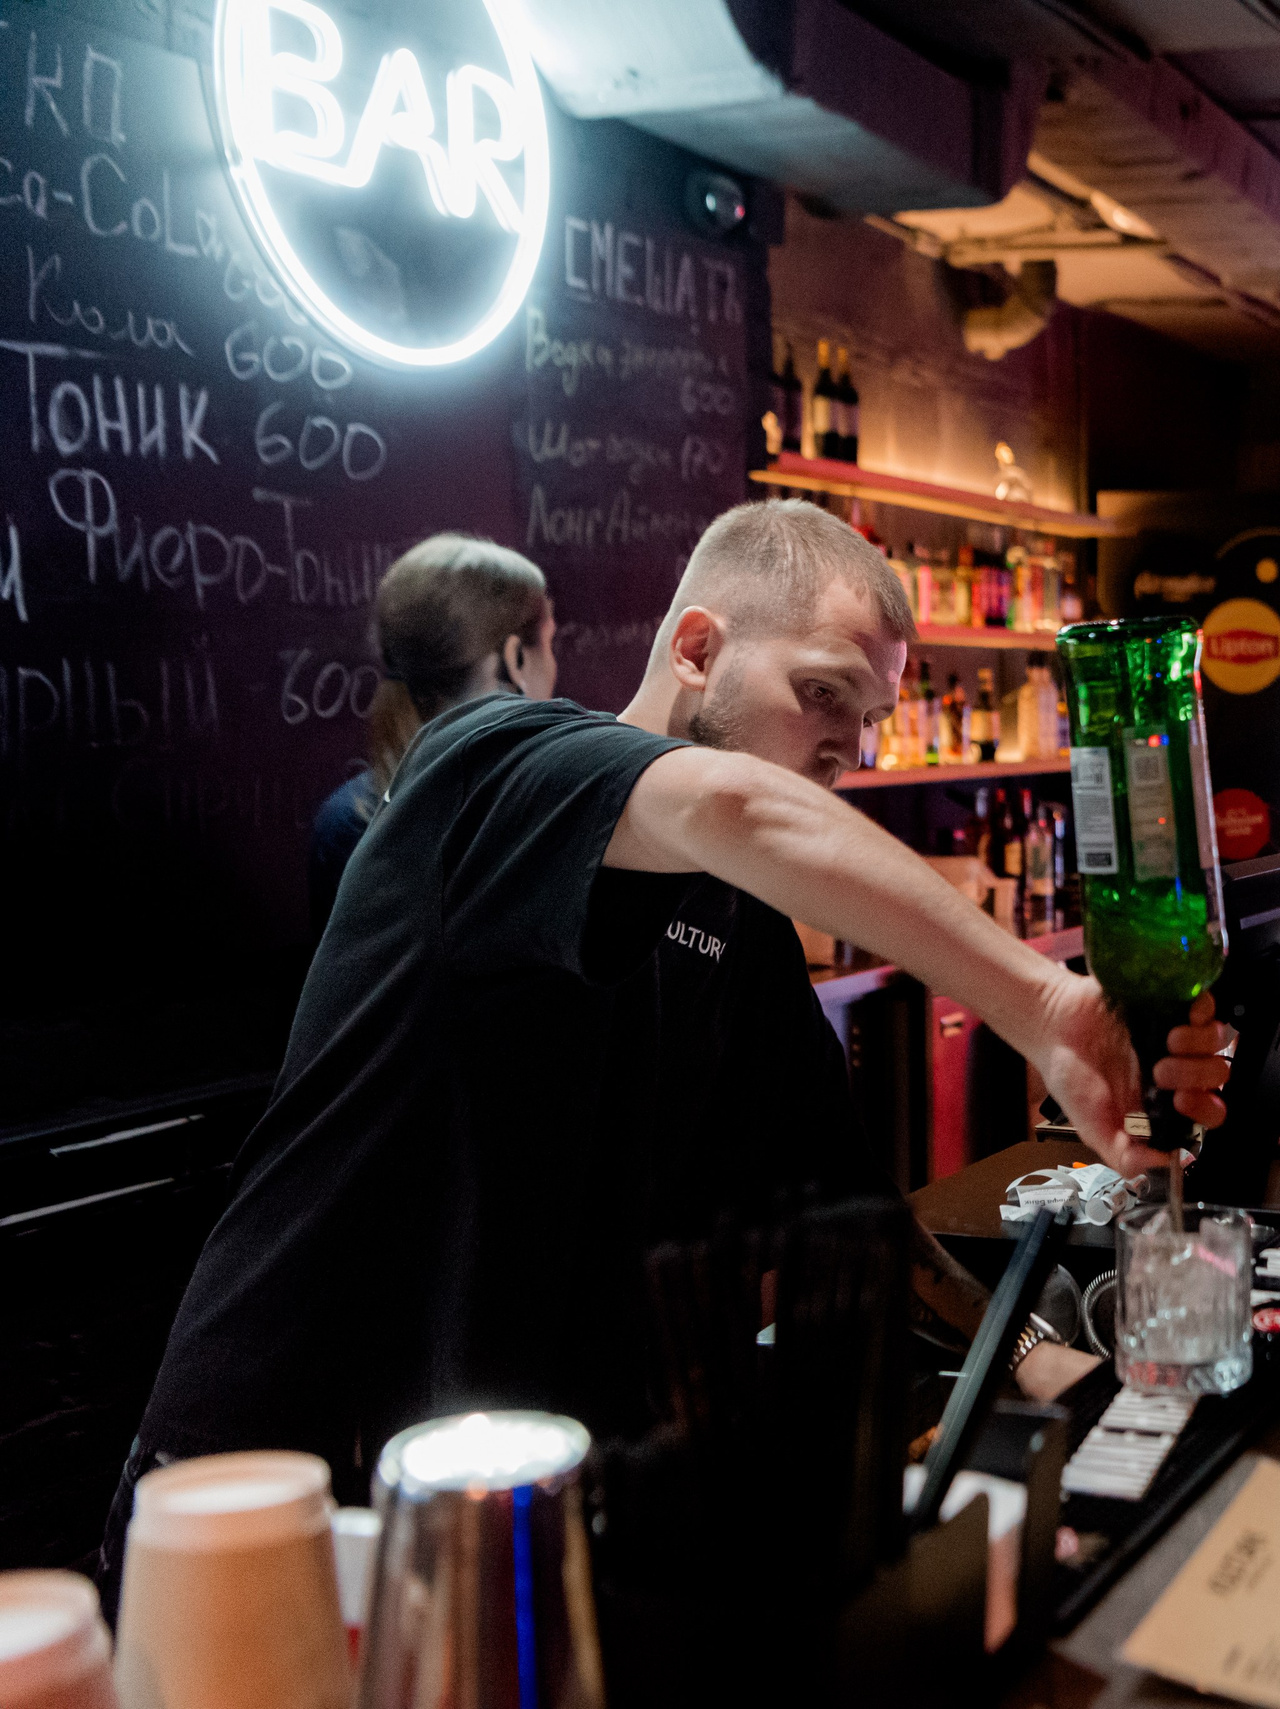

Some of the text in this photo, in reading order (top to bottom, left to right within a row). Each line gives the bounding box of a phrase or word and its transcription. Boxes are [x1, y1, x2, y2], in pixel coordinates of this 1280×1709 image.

[246, 0, 522, 234] BAR
[254, 402, 388, 483] 600
[664, 920, 727, 963] ULTUR
